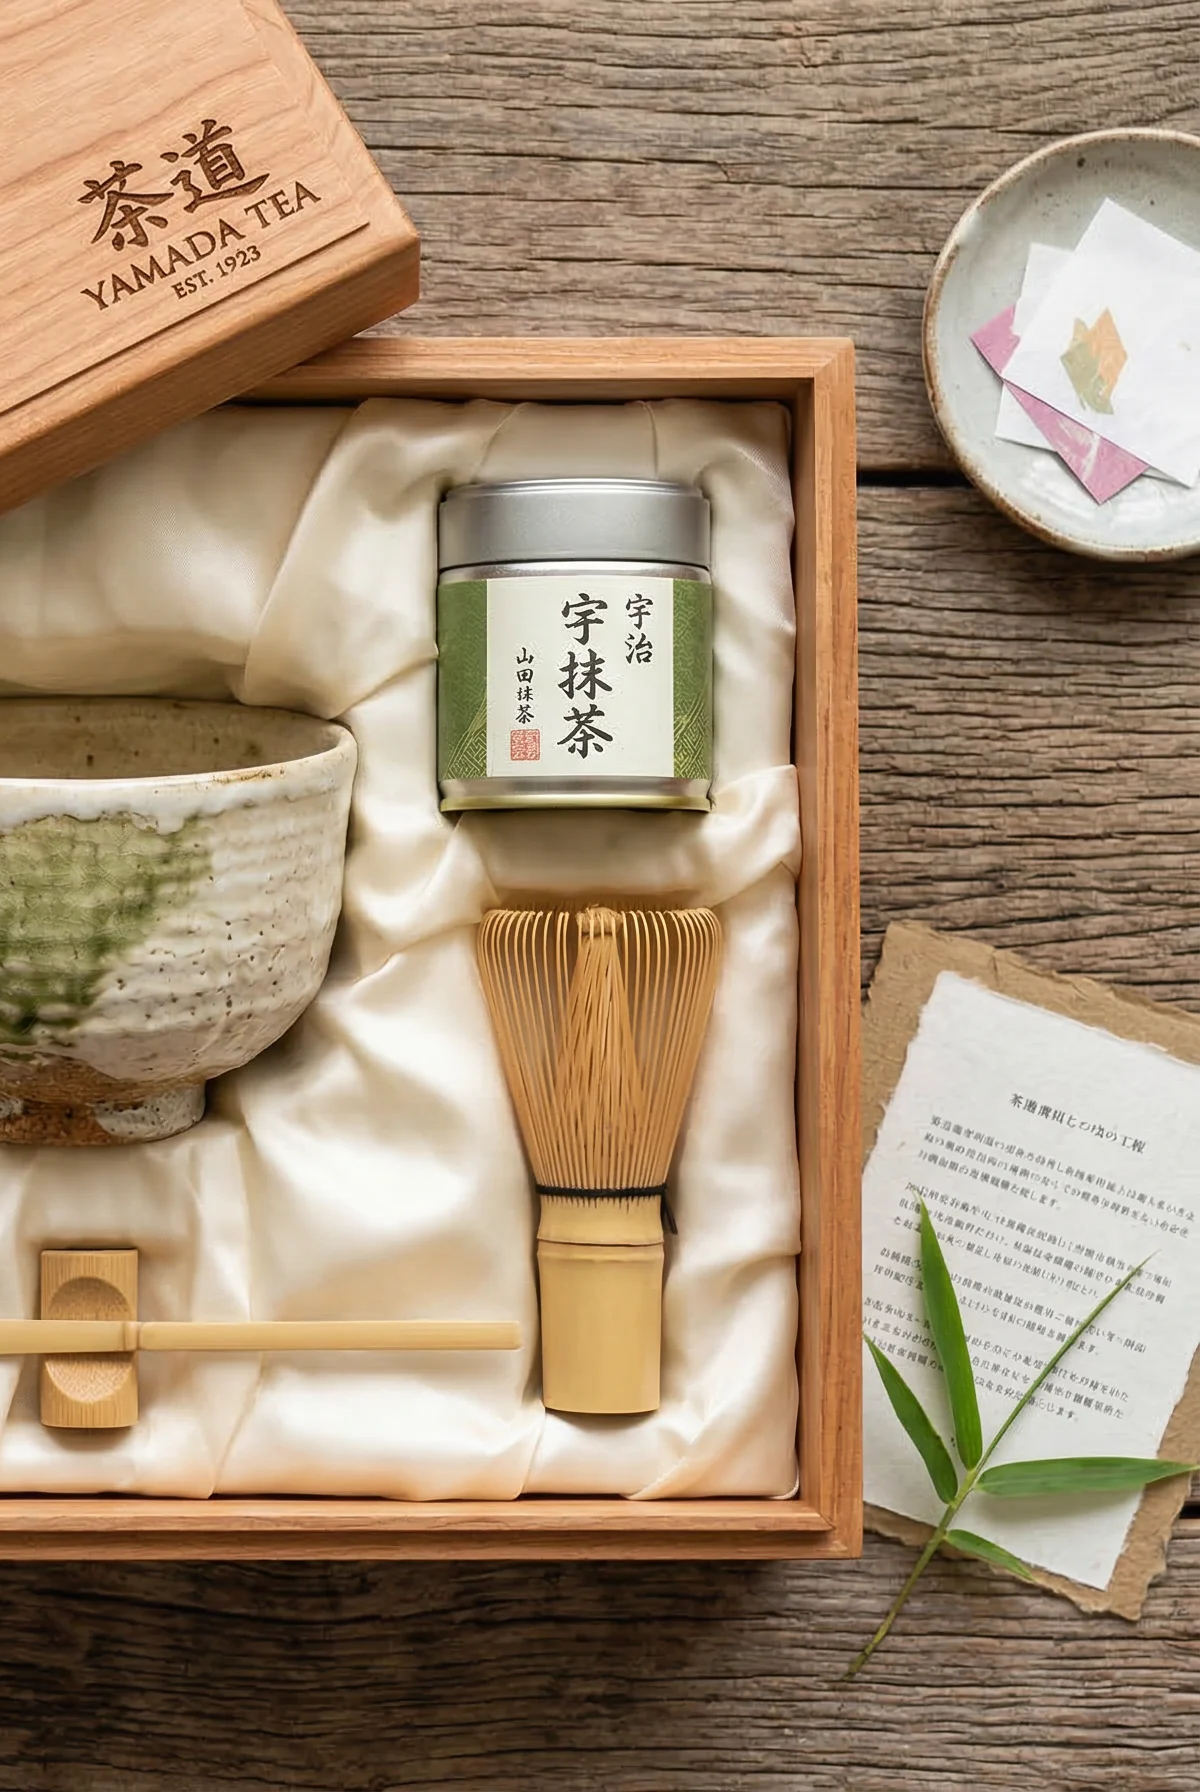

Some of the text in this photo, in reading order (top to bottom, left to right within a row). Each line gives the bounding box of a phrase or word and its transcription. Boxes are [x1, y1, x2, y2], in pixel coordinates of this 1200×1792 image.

[77, 118, 270, 252] 茶道
[80, 180, 322, 311] YAMADA TEA
[171, 245, 262, 300] EST. 1923
[557, 593, 614, 759] 宇抹茶
[625, 593, 654, 664] 宇治
[515, 647, 535, 724] 山田抹茶
